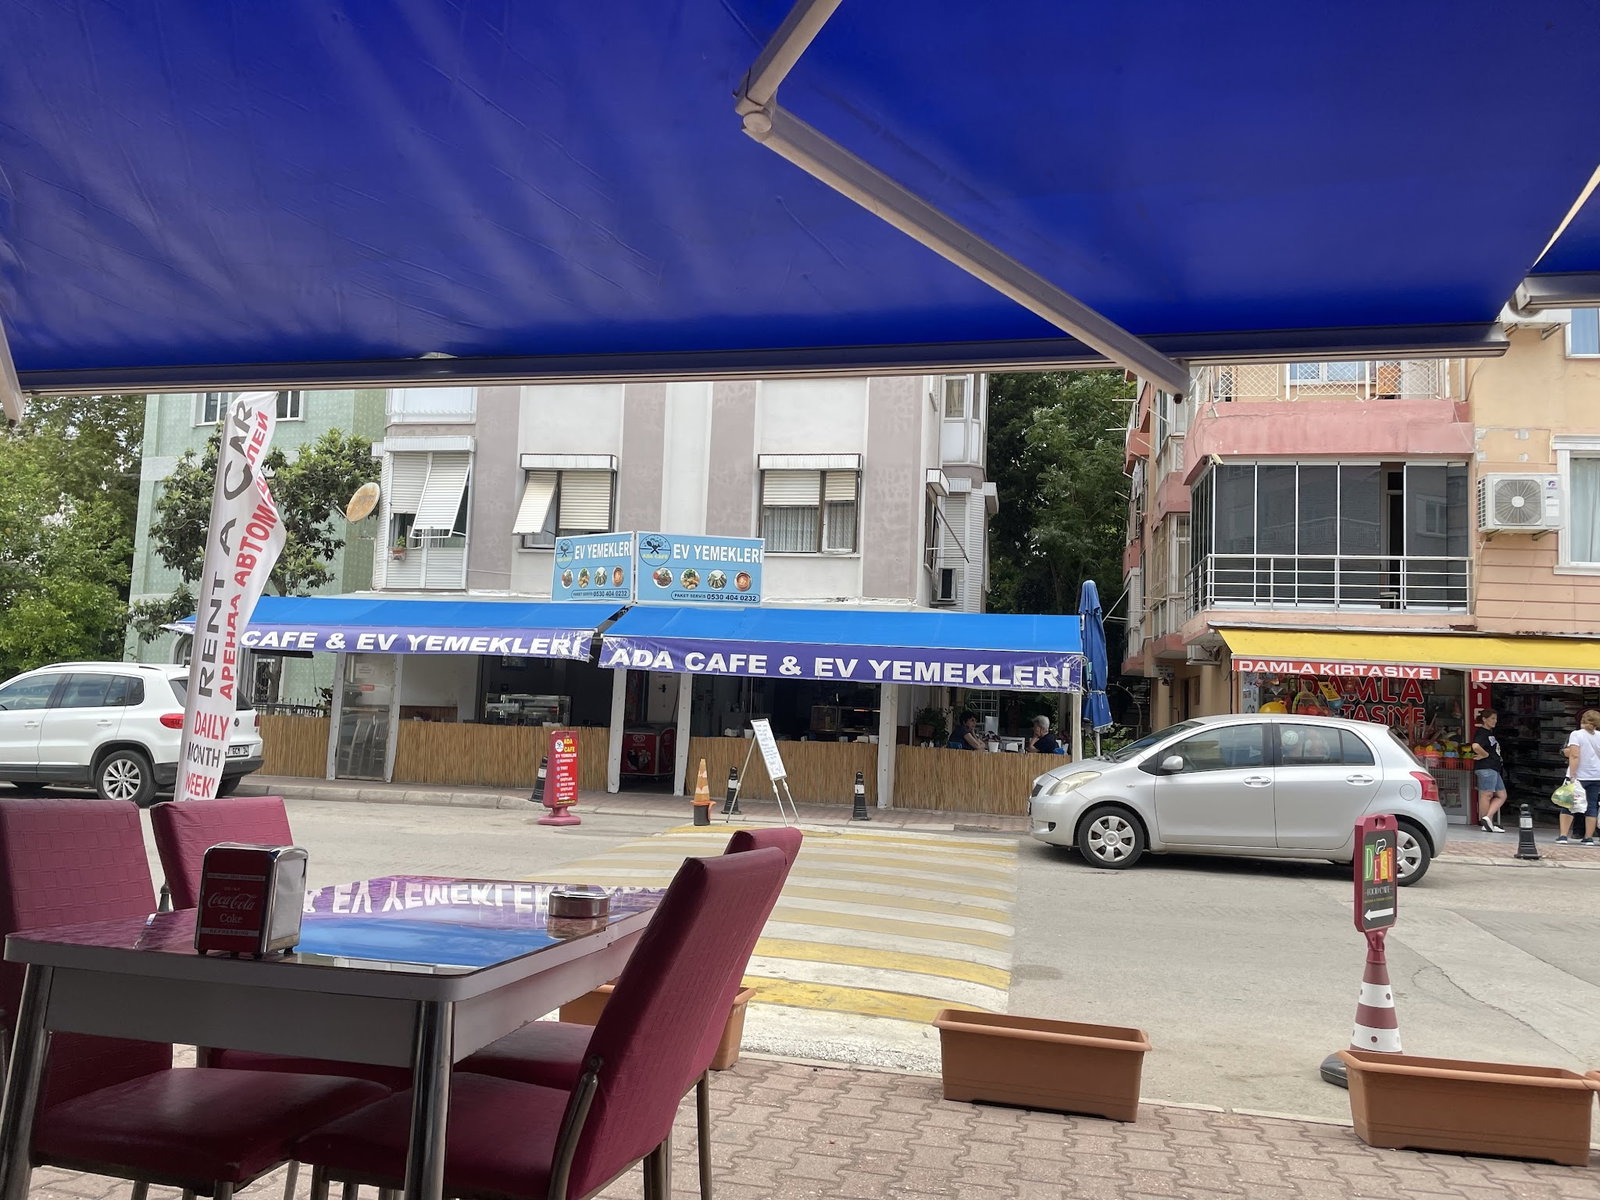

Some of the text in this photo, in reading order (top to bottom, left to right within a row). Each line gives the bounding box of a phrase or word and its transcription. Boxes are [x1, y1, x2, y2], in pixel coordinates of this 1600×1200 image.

[198, 400, 253, 697] RENT A CAR
[574, 545, 585, 560] EV
[673, 544, 690, 560] EV
[220, 593, 241, 700] АРЕНДА
[241, 630, 319, 649] CAFE
[325, 632, 346, 650] &
[356, 633, 398, 651] EV
[609, 647, 1070, 687] ADA CAFE & EV YEMEKLERİ
[1239, 660, 1316, 675] DAMLA
[1478, 671, 1559, 685] DAMLA
[194, 711, 229, 741] DAILY
[187, 741, 221, 769] MONTH
